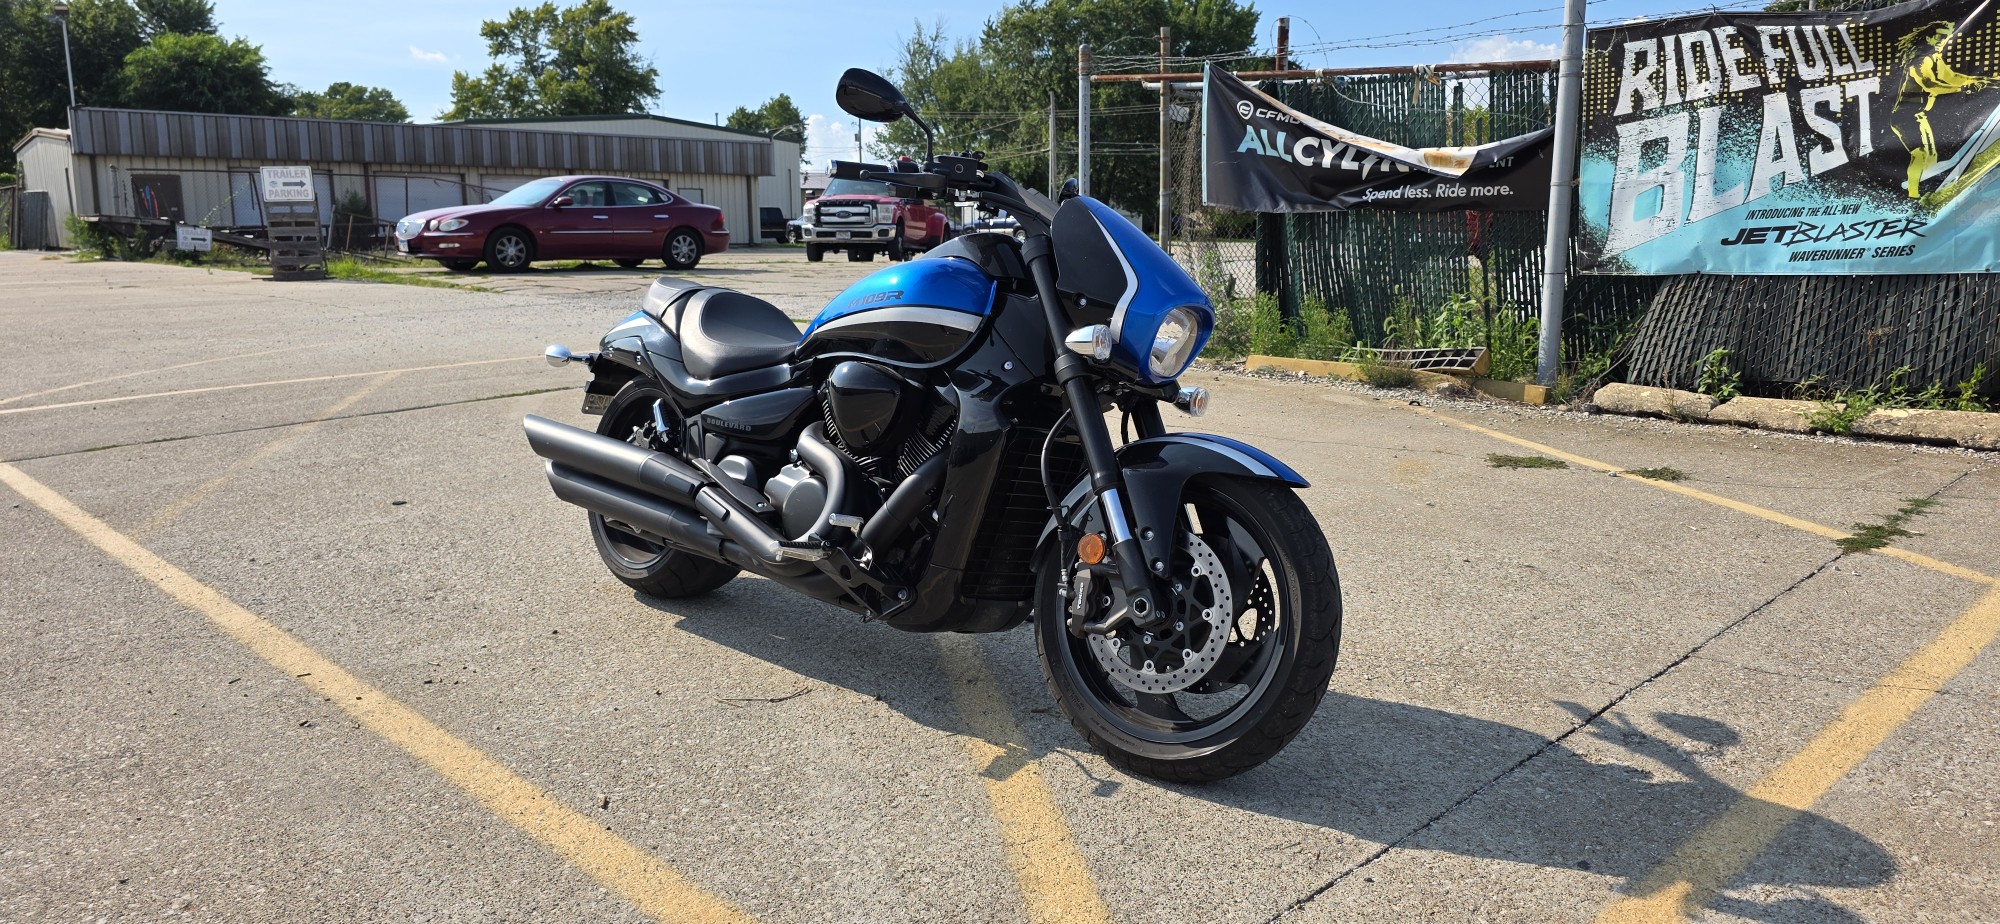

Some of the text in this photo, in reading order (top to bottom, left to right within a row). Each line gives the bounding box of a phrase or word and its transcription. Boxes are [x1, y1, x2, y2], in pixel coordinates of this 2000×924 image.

[1613, 25, 1875, 116] RIDE FULL
[267, 170, 306, 178] TRAILER
[1604, 76, 1880, 257] BLAST
[269, 189, 309, 198] PARKING
[1362, 183, 1514, 202] Spend less. Ride more.
[1745, 204, 1861, 221] INTRODUCING THE ALL-NEW
[1871, 244, 1916, 259] SERIES
[706, 417, 752, 432] BOULEVARD
